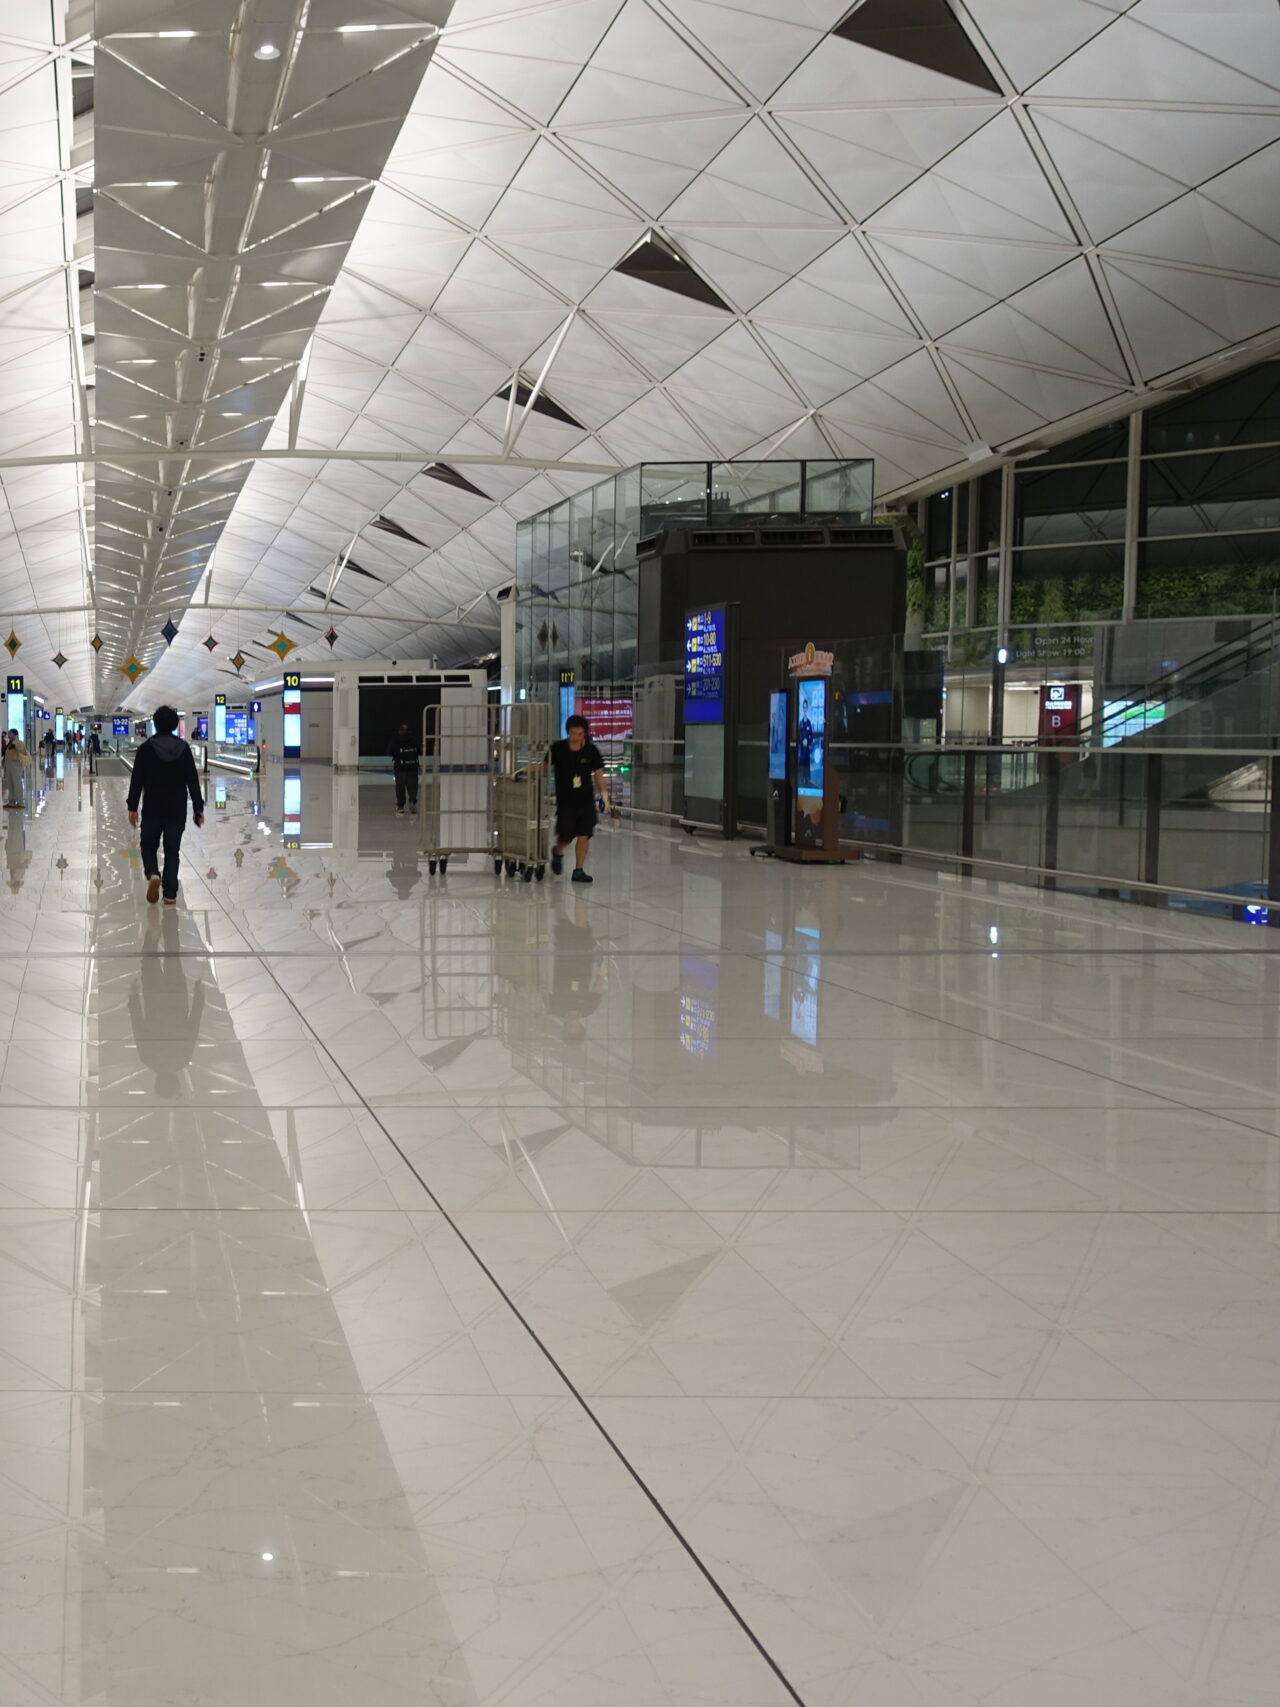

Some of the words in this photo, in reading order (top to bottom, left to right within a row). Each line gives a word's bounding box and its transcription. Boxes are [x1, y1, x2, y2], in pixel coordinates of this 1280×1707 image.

[1073, 635, 1095, 643] Hour
[10, 679, 21, 690] 11
[286, 676, 298, 687] 10
[216, 696, 225, 704] 12
[1051, 715, 1061, 728] B
